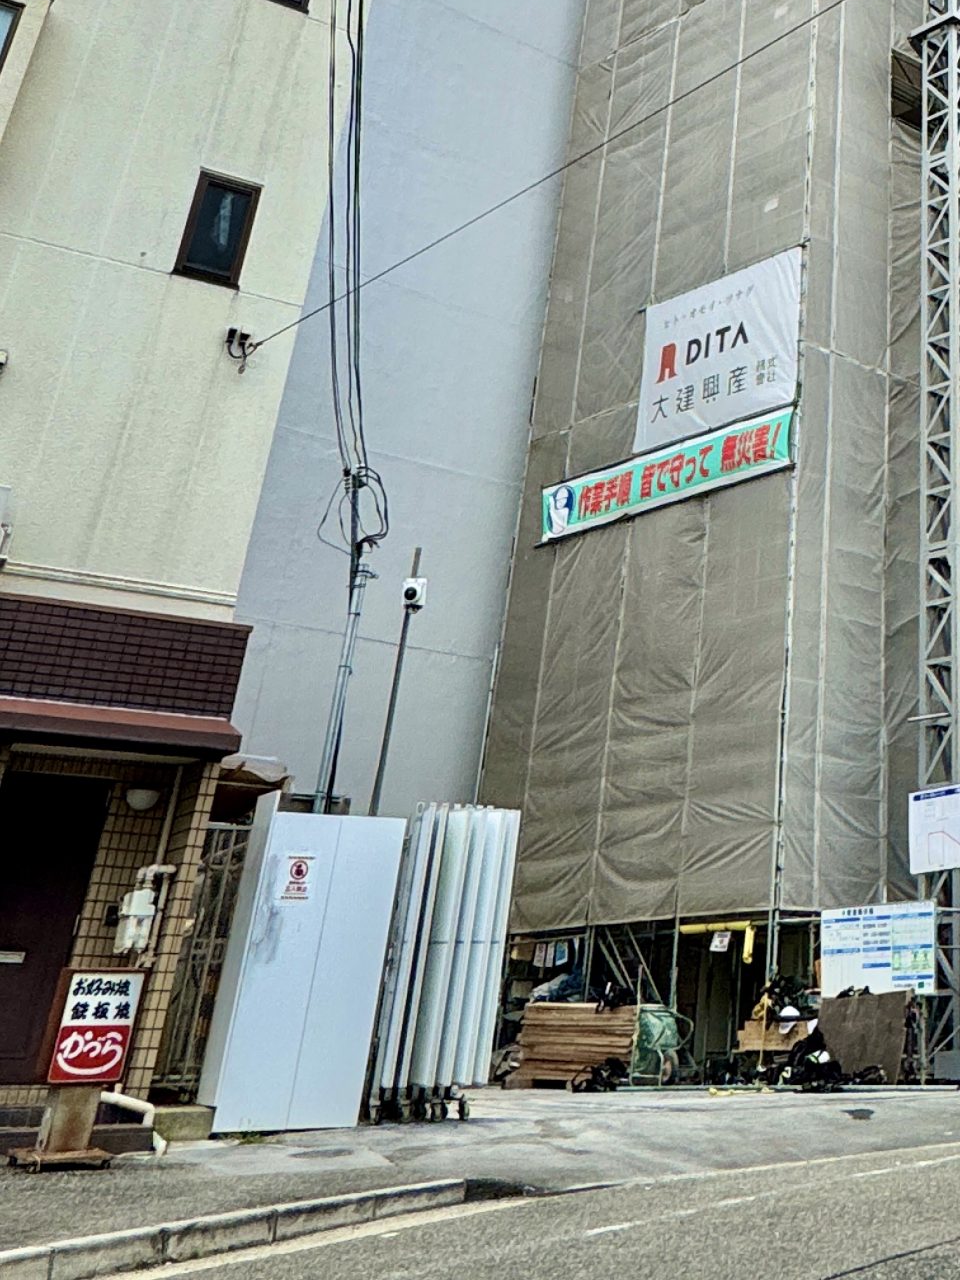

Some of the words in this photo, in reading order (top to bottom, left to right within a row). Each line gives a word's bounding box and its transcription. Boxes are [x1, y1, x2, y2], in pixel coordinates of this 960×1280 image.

[685, 321, 749, 366] DITA
[650, 365, 748, 424] 大建興産
[578, 470, 634, 521] 作業手順
[640, 444, 714, 500] 皆で守って
[73, 977, 131, 996] お好み焼
